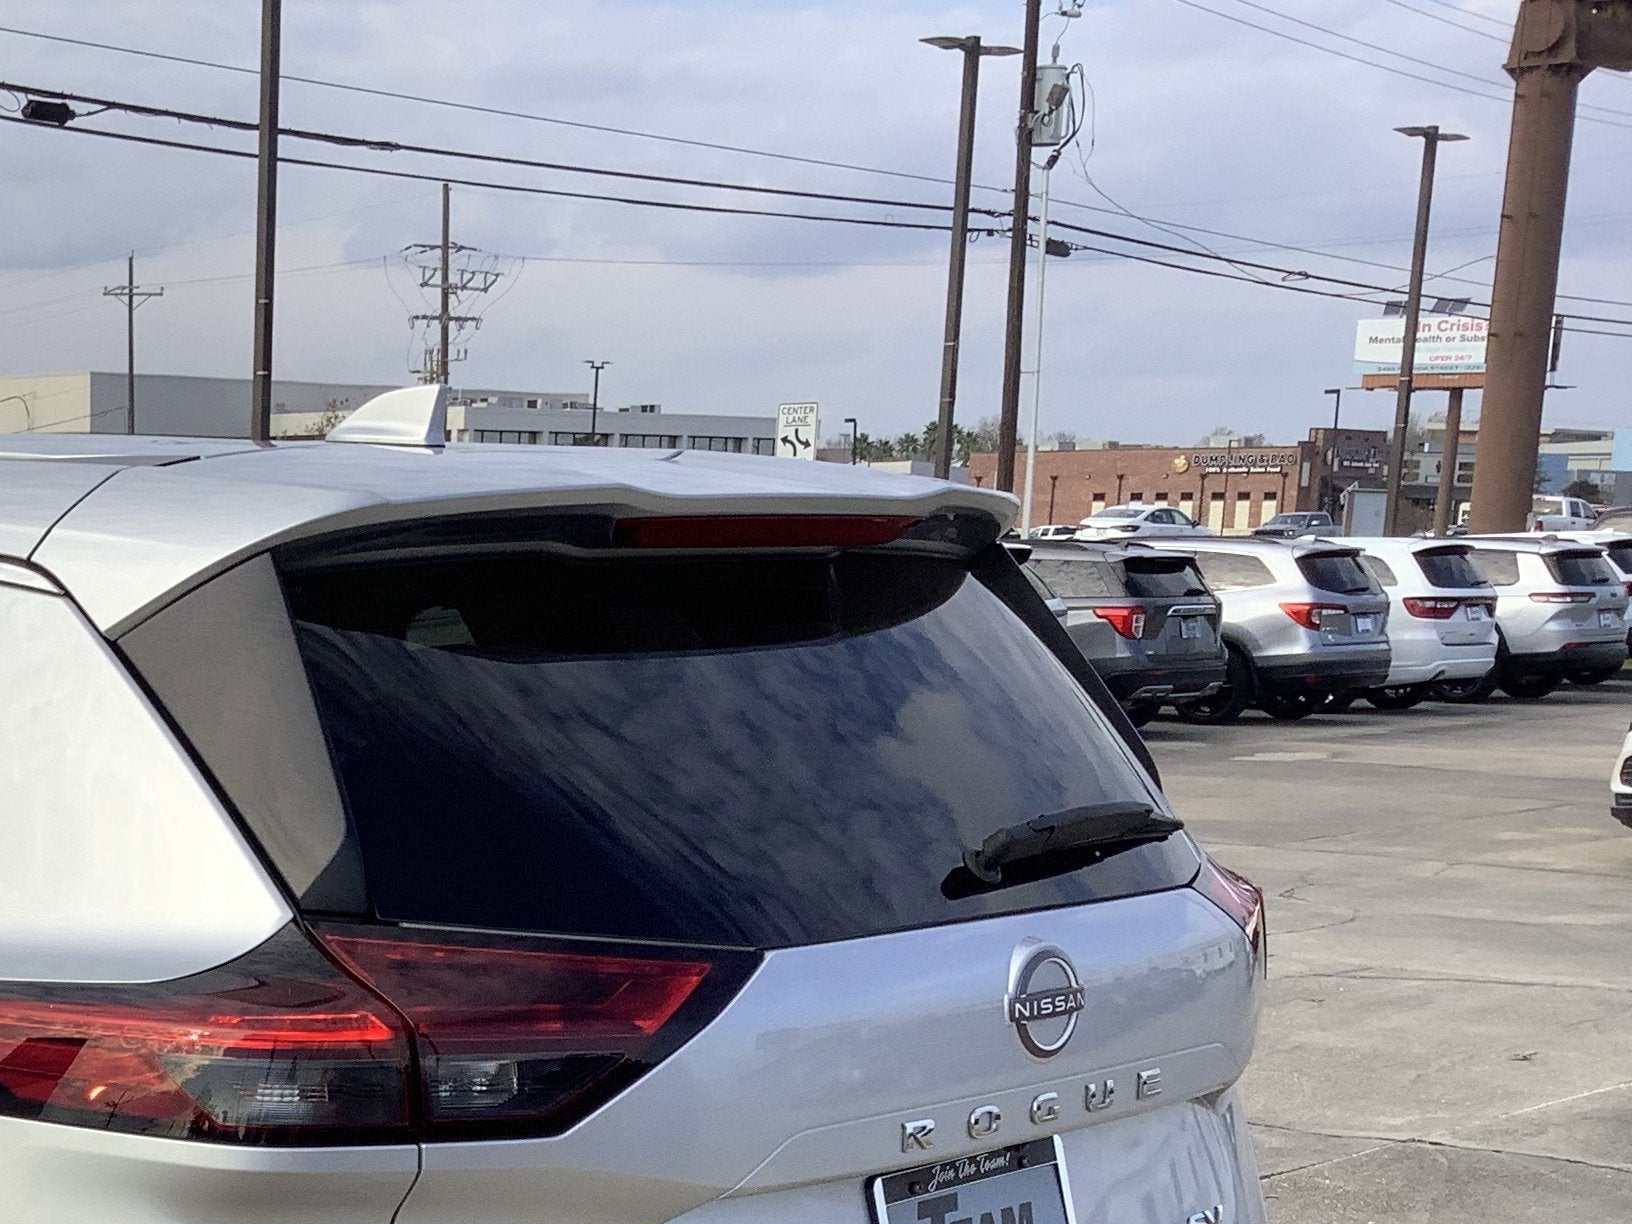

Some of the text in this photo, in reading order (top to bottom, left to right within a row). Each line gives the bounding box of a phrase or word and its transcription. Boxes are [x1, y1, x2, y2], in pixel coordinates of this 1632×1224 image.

[1445, 335, 1456, 343] or
[1459, 333, 1487, 343] Subs
[781, 405, 816, 416] CENTER
[785, 415, 810, 424] LANE
[1014, 990, 1085, 1019] NISSAN
[901, 1066, 1164, 1154] ROGUE
[928, 1152, 1011, 1192] Join The Team!
